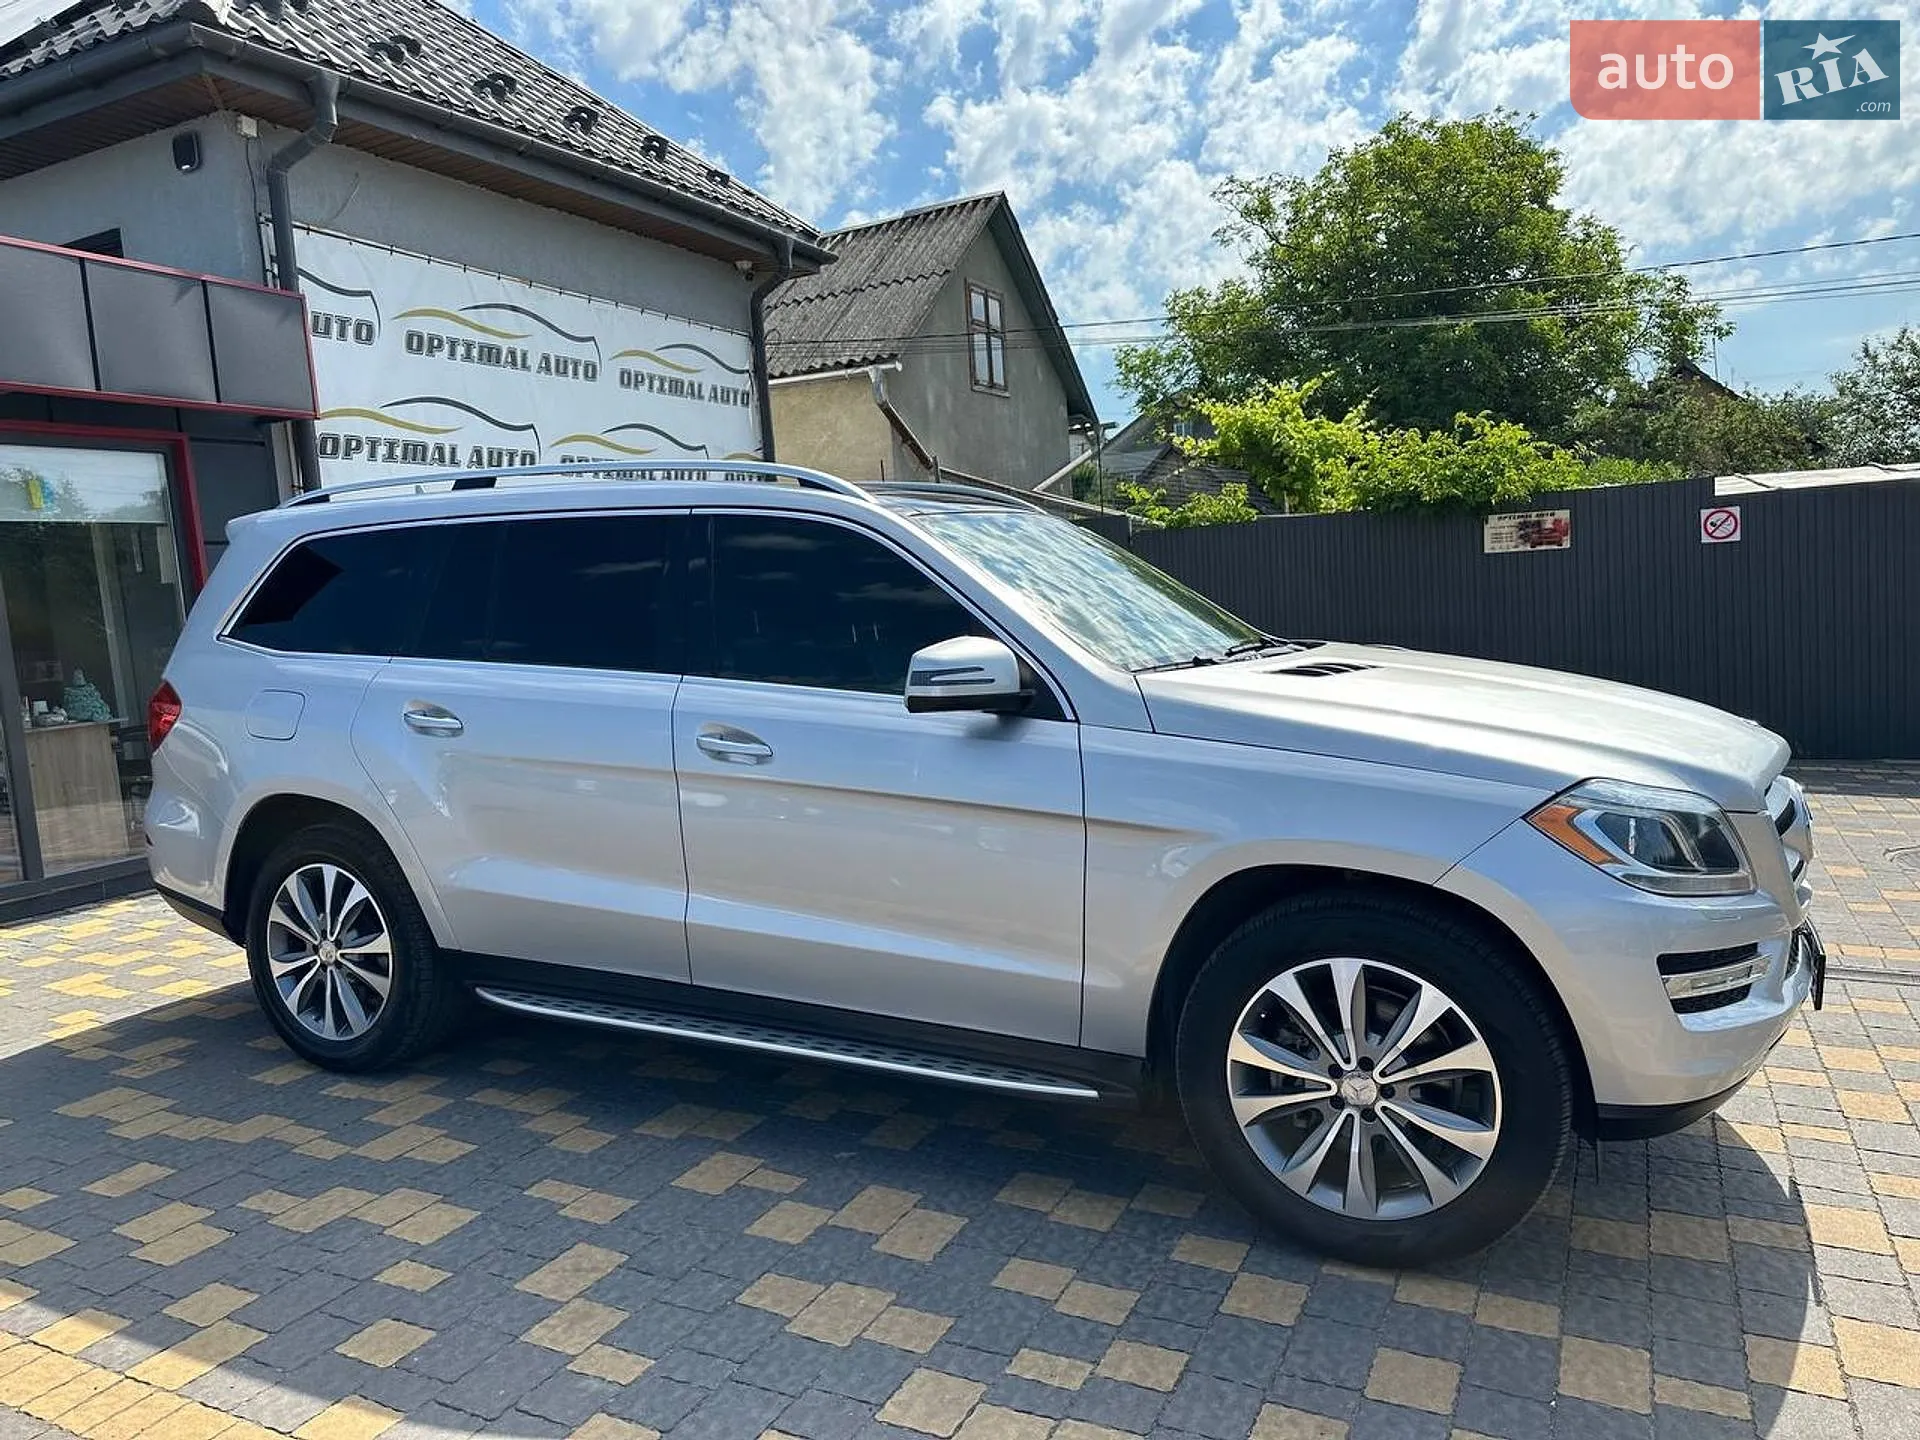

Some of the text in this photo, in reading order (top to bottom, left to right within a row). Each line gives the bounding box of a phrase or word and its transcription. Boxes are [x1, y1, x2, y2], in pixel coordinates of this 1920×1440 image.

[311, 310, 375, 346] UTO
[404, 329, 598, 383] OPTIMAL AUTO
[619, 367, 750, 408] OPTIMAL AUTO
[318, 432, 537, 469] OPTIMAL AUTO
